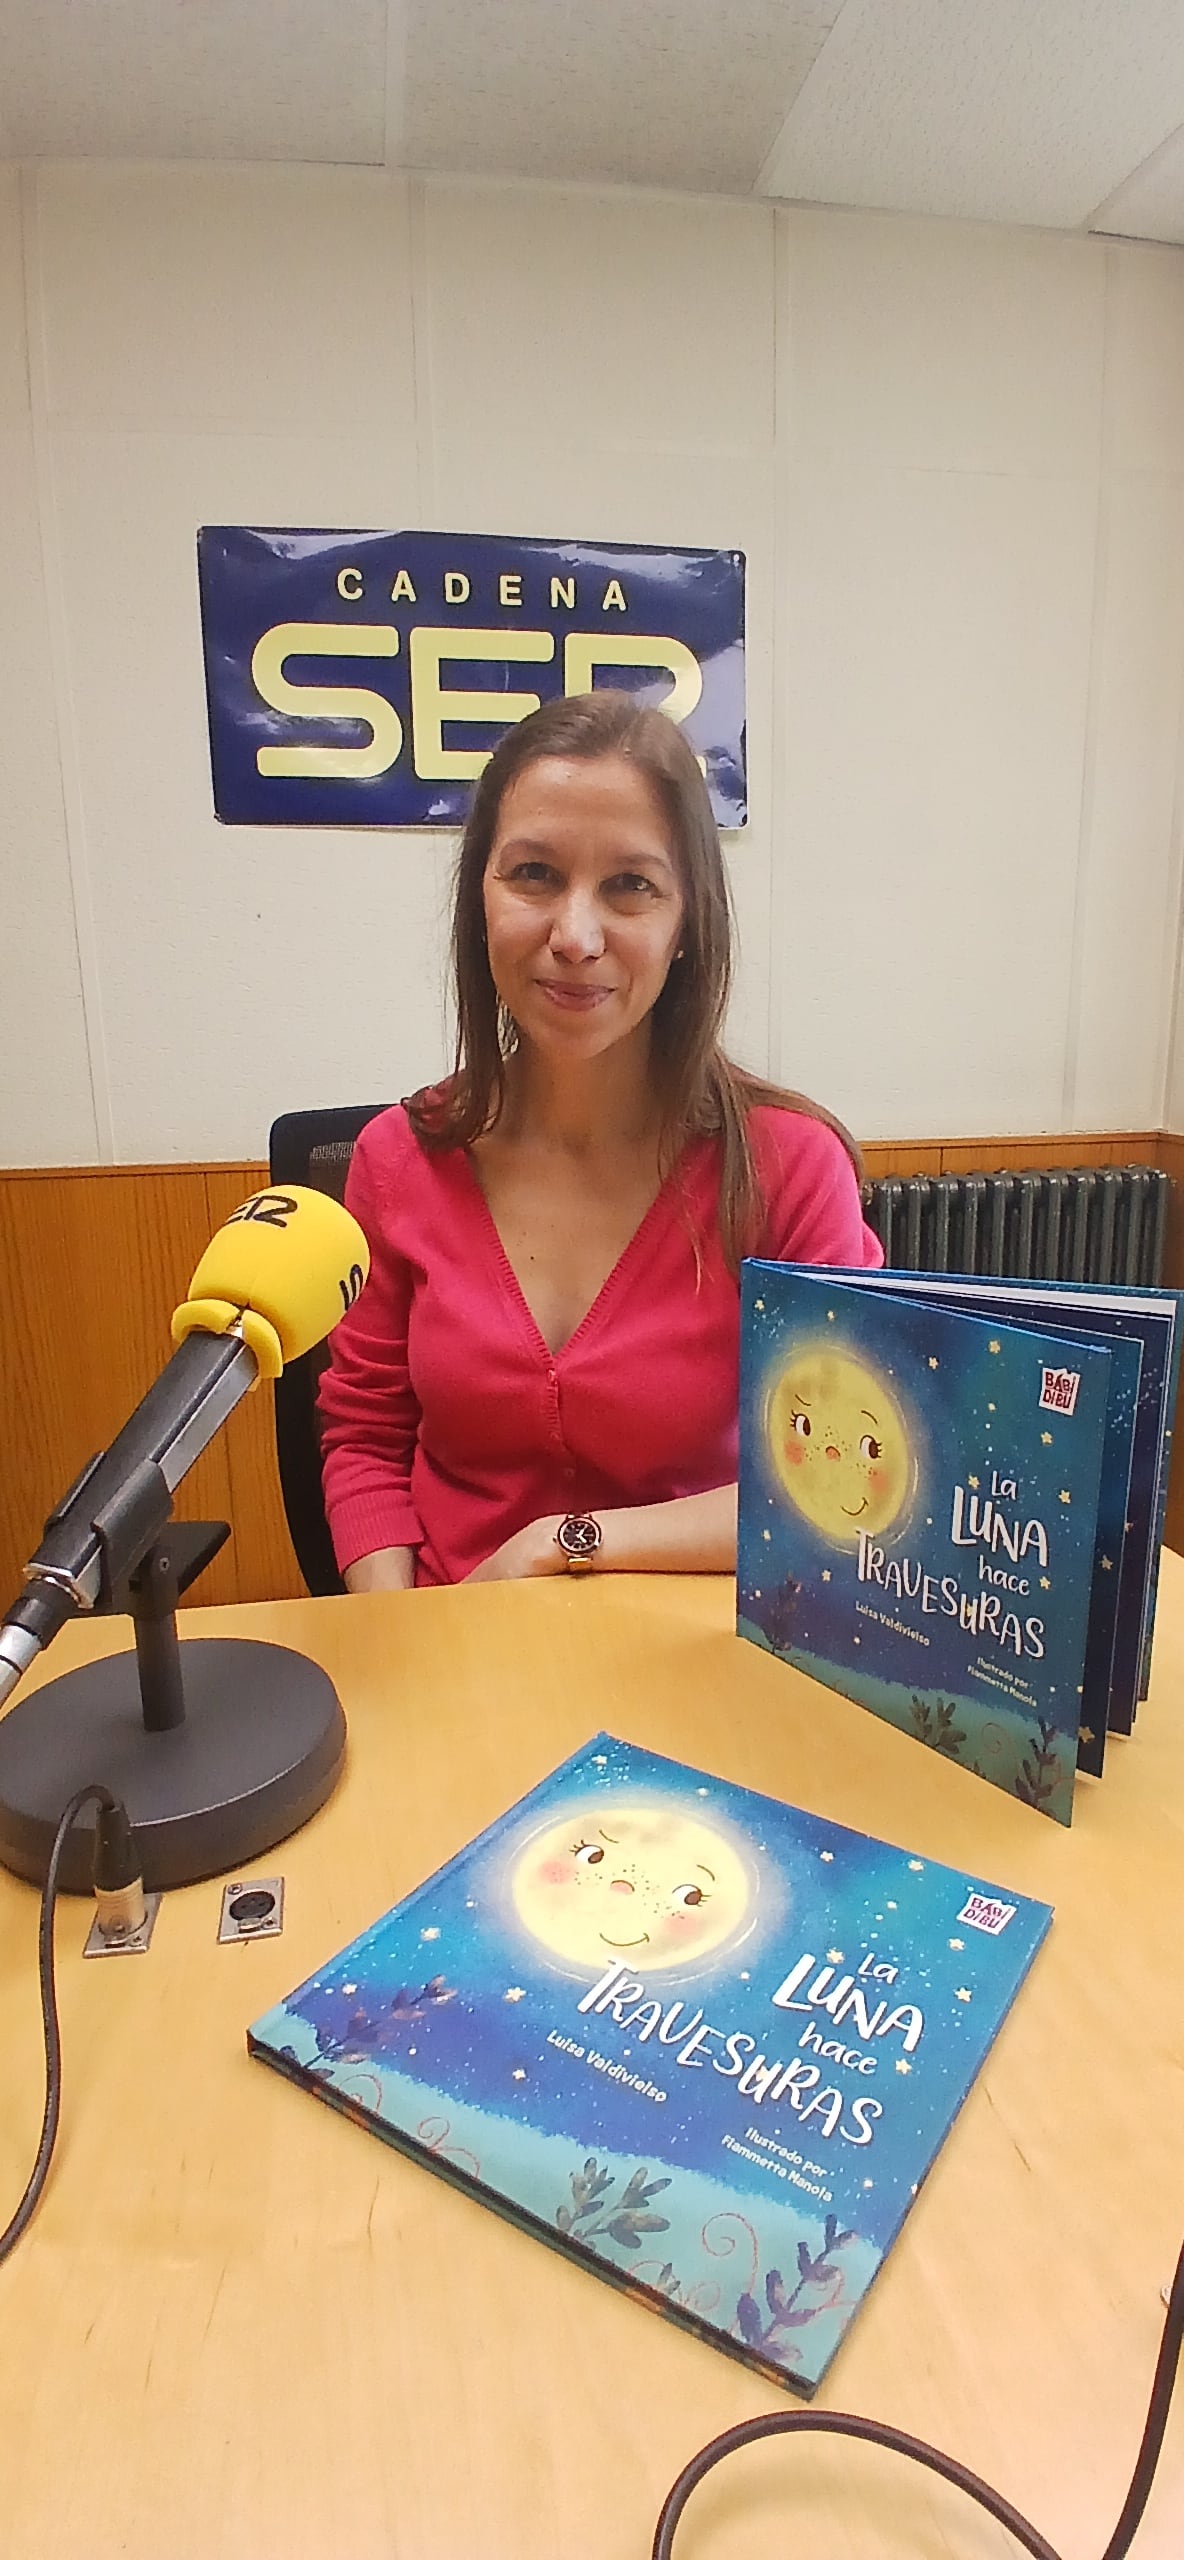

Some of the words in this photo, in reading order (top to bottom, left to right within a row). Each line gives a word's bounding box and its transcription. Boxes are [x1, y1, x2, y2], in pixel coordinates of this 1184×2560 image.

[336, 567, 627, 612] CADENA
[991, 1470, 1017, 1500] La
[951, 1485, 1048, 1567] LUNA
[856, 1526, 1044, 1658] TRAVESURAS
[978, 1554, 1031, 1596] hace
[855, 1600, 878, 1620] Luisa
[879, 1611, 930, 1647] Valdivielso
[976, 1656, 1014, 1682] Ilustrado
[1014, 1676, 1029, 1689] por
[857, 1952, 899, 1984] La
[772, 1953, 923, 2052] LUNA
[546, 2029, 586, 2058] Luisa
[586, 2049, 667, 2102] Valdivielso
[577, 1958, 883, 2145] TRAVESURAS
[798, 2021, 878, 2075] hace
[721, 2134, 787, 2178] Fiammetta
[744, 2127, 803, 2165] Ilustrado
[801, 2160, 829, 2178] por
